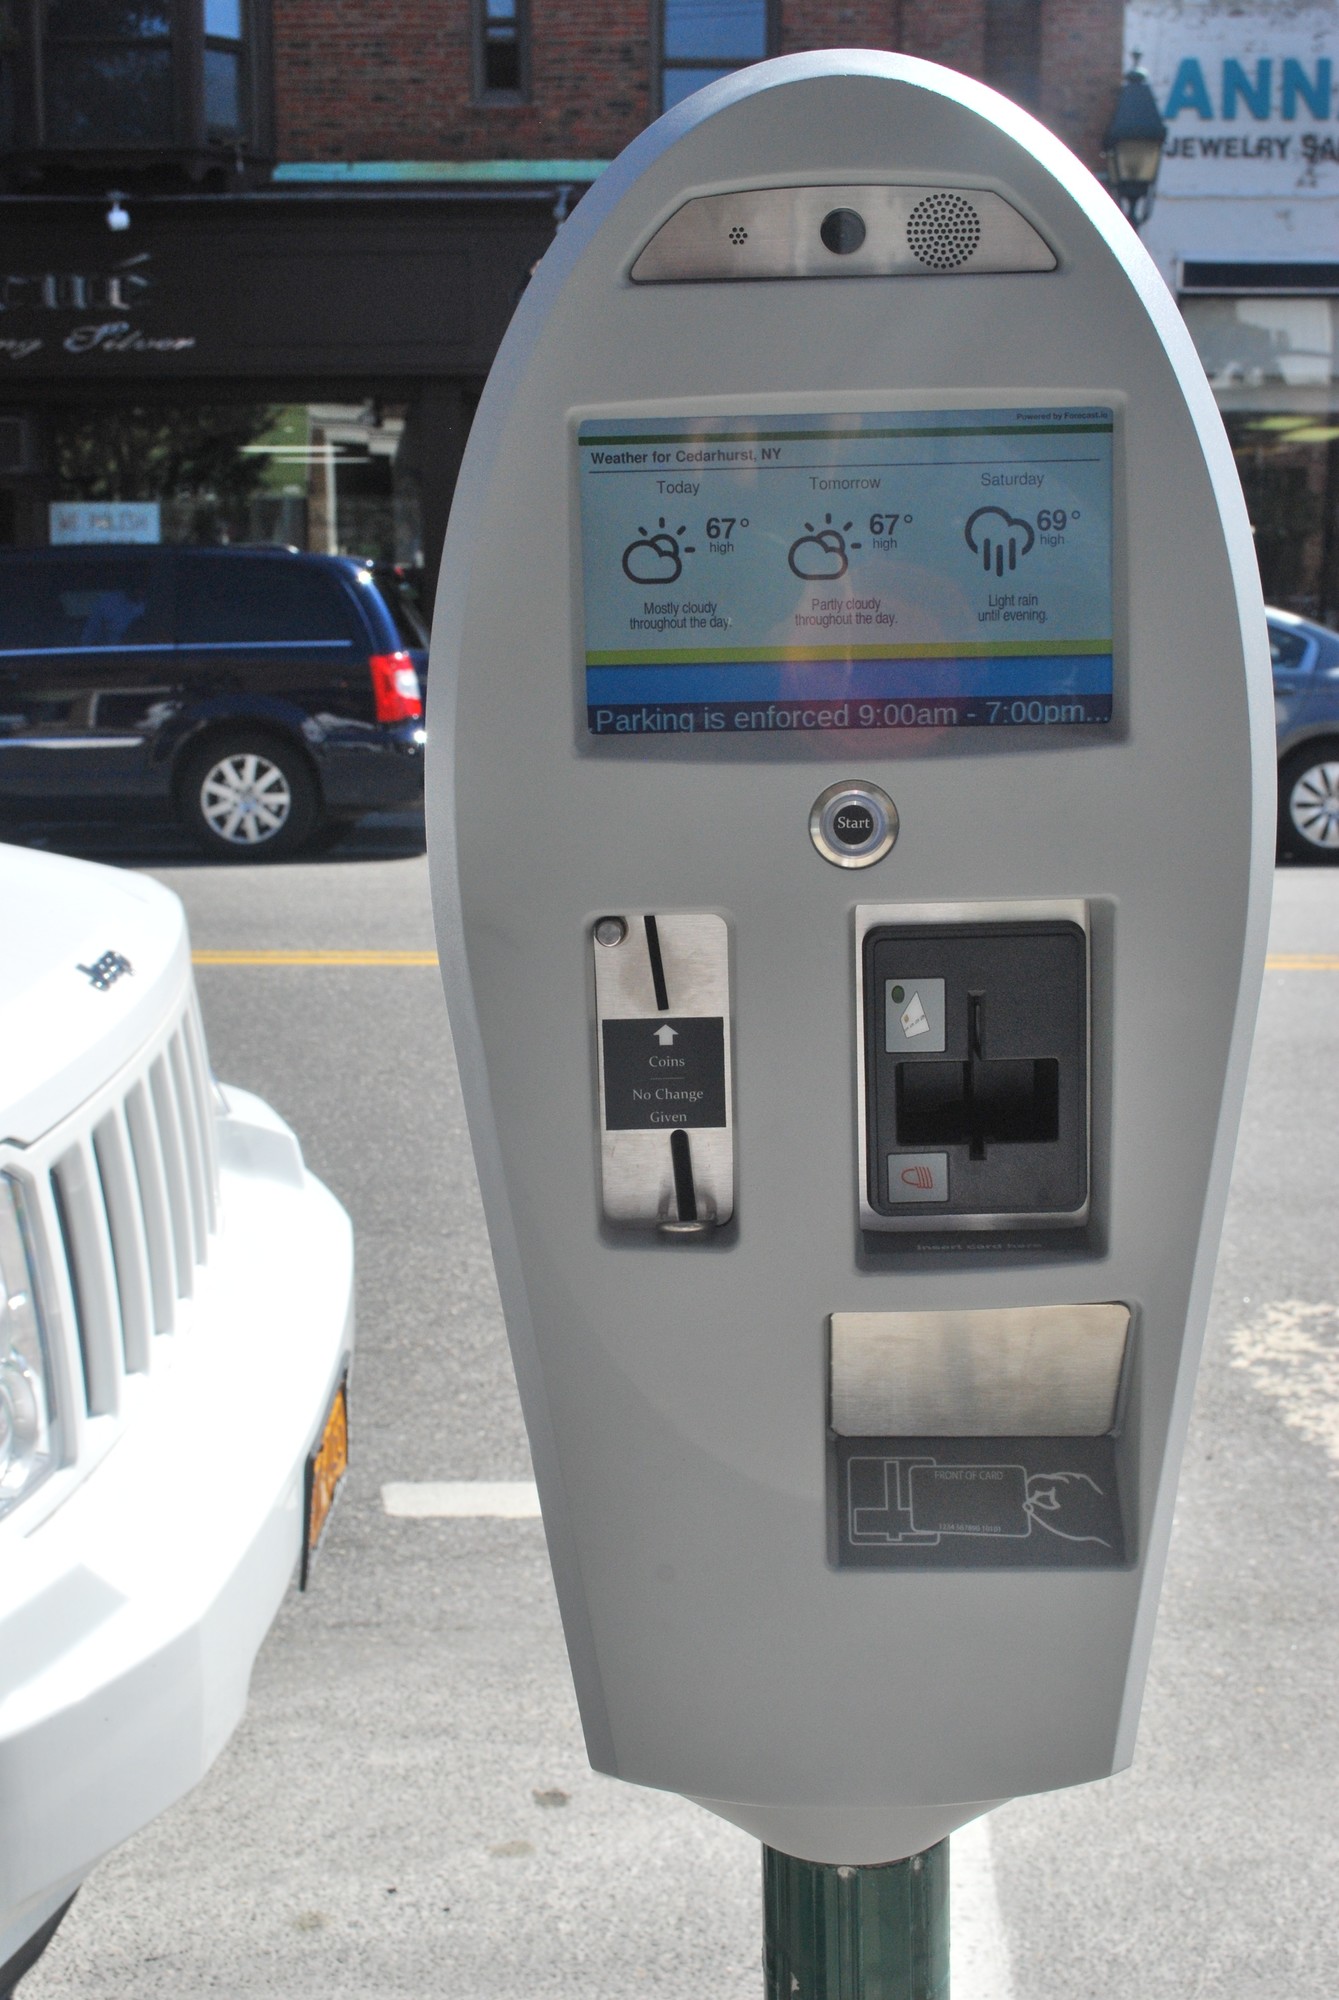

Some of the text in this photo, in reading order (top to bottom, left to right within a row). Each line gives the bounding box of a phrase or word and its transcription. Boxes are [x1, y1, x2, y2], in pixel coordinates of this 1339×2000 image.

[1164, 57, 1339, 121] ANN
[1165, 133, 1339, 162] JEWELRY SA
[1016, 412, 1052, 420] Powered
[1053, 412, 1062, 421] by
[591, 448, 782, 465] Weather for Cedarhurst, NY
[809, 476, 881, 491] Tomorrow
[981, 472, 1045, 488] Saturday
[656, 481, 700, 496] Today
[710, 541, 734, 555] high
[872, 537, 898, 551] high
[1040, 533, 1065, 548] high
[644, 601, 717, 616] Mostly cloudy
[812, 597, 881, 614] Partly cloudy
[988, 593, 1039, 609] Light rain
[630, 616, 733, 632] throughout the day.
[795, 612, 899, 628] throughout the day.
[978, 609, 1048, 624] until evening.
[596, 708, 694, 733] Parking
[704, 707, 725, 730] is
[734, 704, 849, 728] enforced
[858, 703, 957, 726] 9:00am
[837, 816, 870, 829] Start
[648, 1055, 685, 1068] Coins
[632, 1088, 704, 1102] No Change
[650, 1111, 688, 1123] Given
[935, 1471, 1003, 1480] FRONT OF CARD
